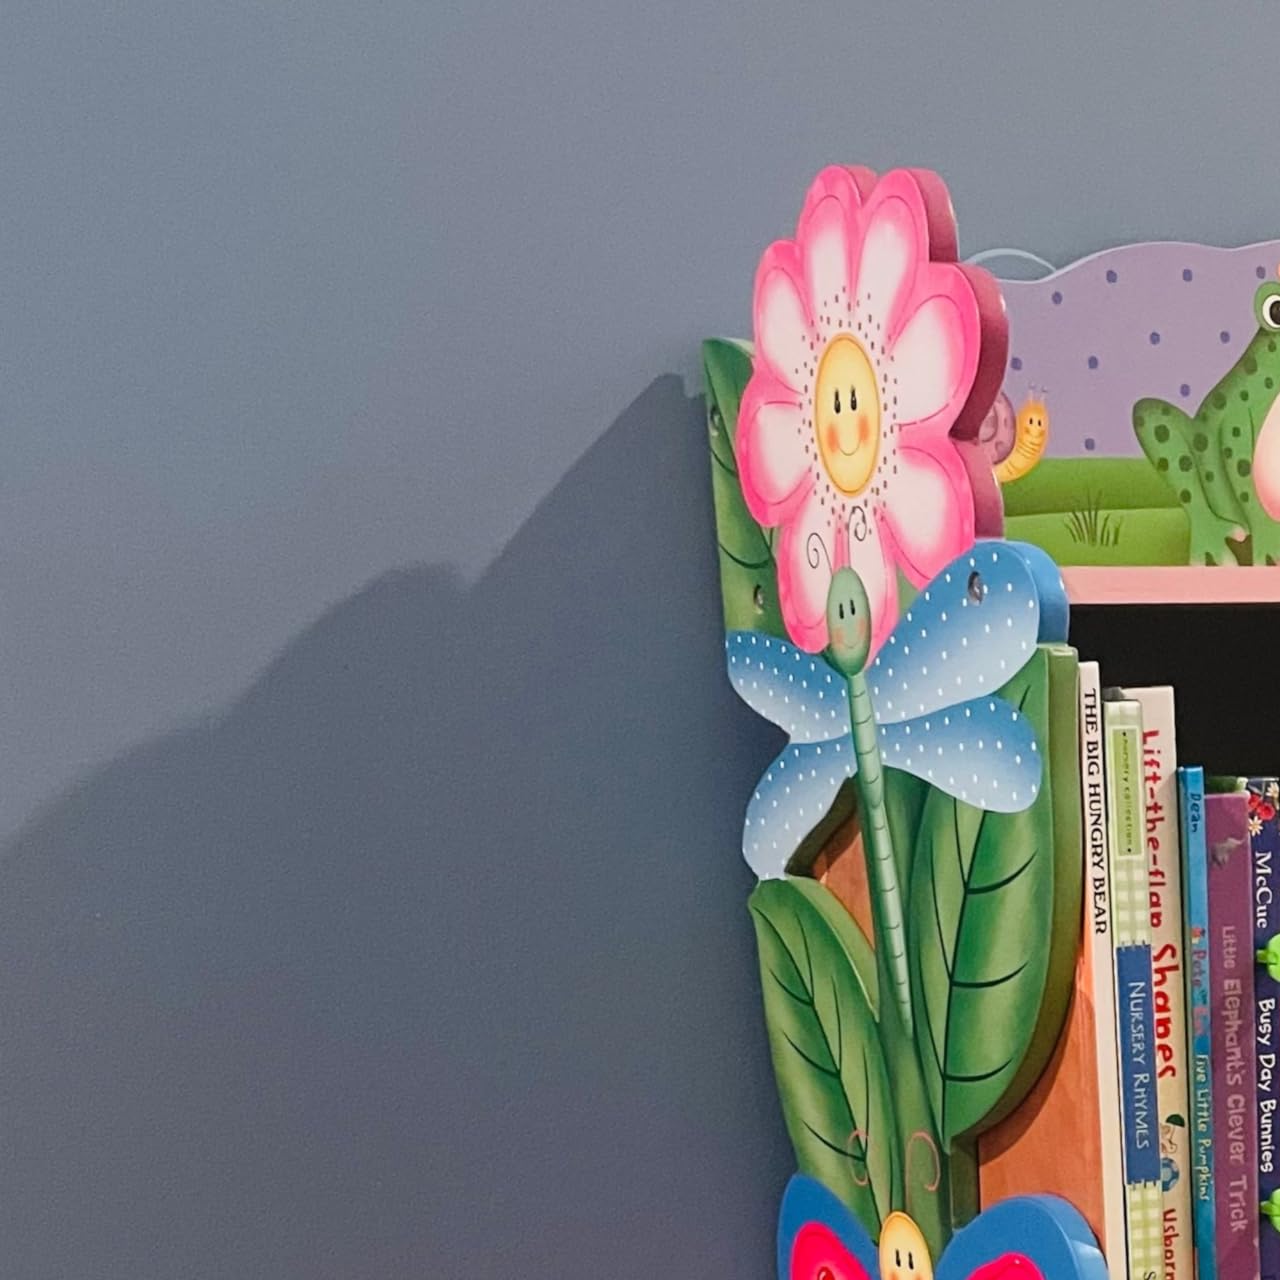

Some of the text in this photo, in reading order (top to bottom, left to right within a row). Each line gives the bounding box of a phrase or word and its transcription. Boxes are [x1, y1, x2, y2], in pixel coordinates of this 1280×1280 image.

[1084, 688, 1107, 935] THE BIG HUNGRY BEAR
[1190, 793, 1201, 833] Dean
[1255, 851, 1273, 929] McCue
[1128, 980, 1150, 1149] NURSERY RHYMES
[1153, 944, 1179, 1078] Shapes
[1221, 925, 1248, 1232] Little Elephant's Clever Trick
[1256, 998, 1278, 1174] Busy Day Bunnies
[1194, 1054, 1213, 1201] Five Little Pumpkins
